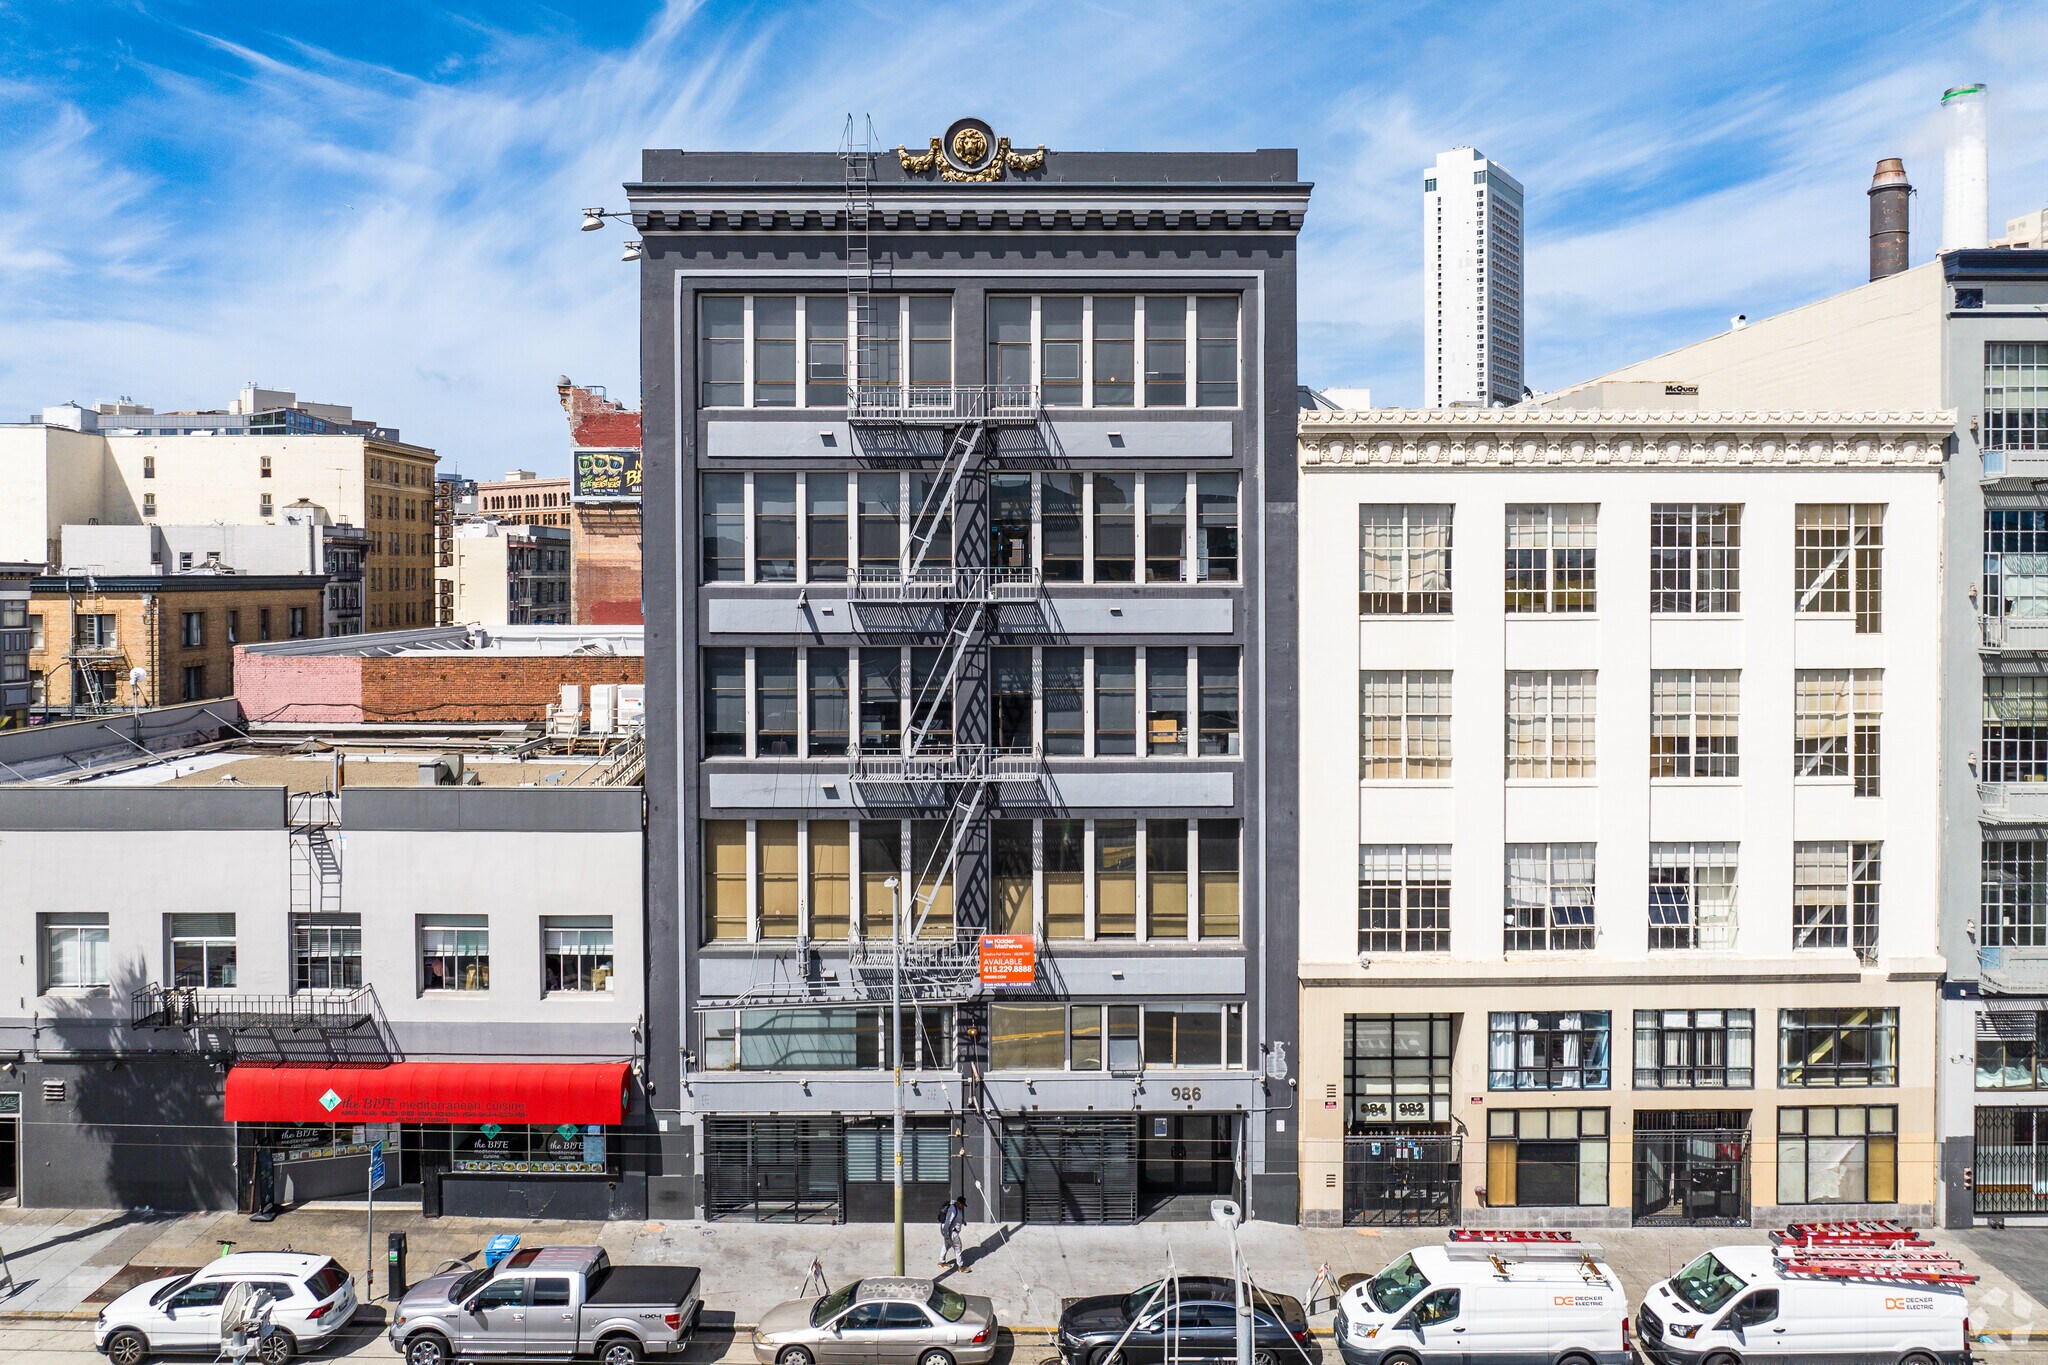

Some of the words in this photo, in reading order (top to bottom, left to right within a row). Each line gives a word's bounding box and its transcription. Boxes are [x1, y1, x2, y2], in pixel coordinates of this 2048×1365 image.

[983, 965, 1032, 973] 415.229.8888
[1171, 1086, 1202, 1101] 986
[341, 1094, 361, 1108] the
[363, 1097, 397, 1109] BITE
[400, 1101, 481, 1110] mediterranean
[486, 1101, 525, 1110] cuisine
[1360, 1103, 1386, 1113] 984
[1399, 1103, 1425, 1113] 982
[474, 1139, 486, 1149] the
[487, 1140, 509, 1149] BITE
[550, 1140, 562, 1150] the
[563, 1141, 584, 1150] BITE
